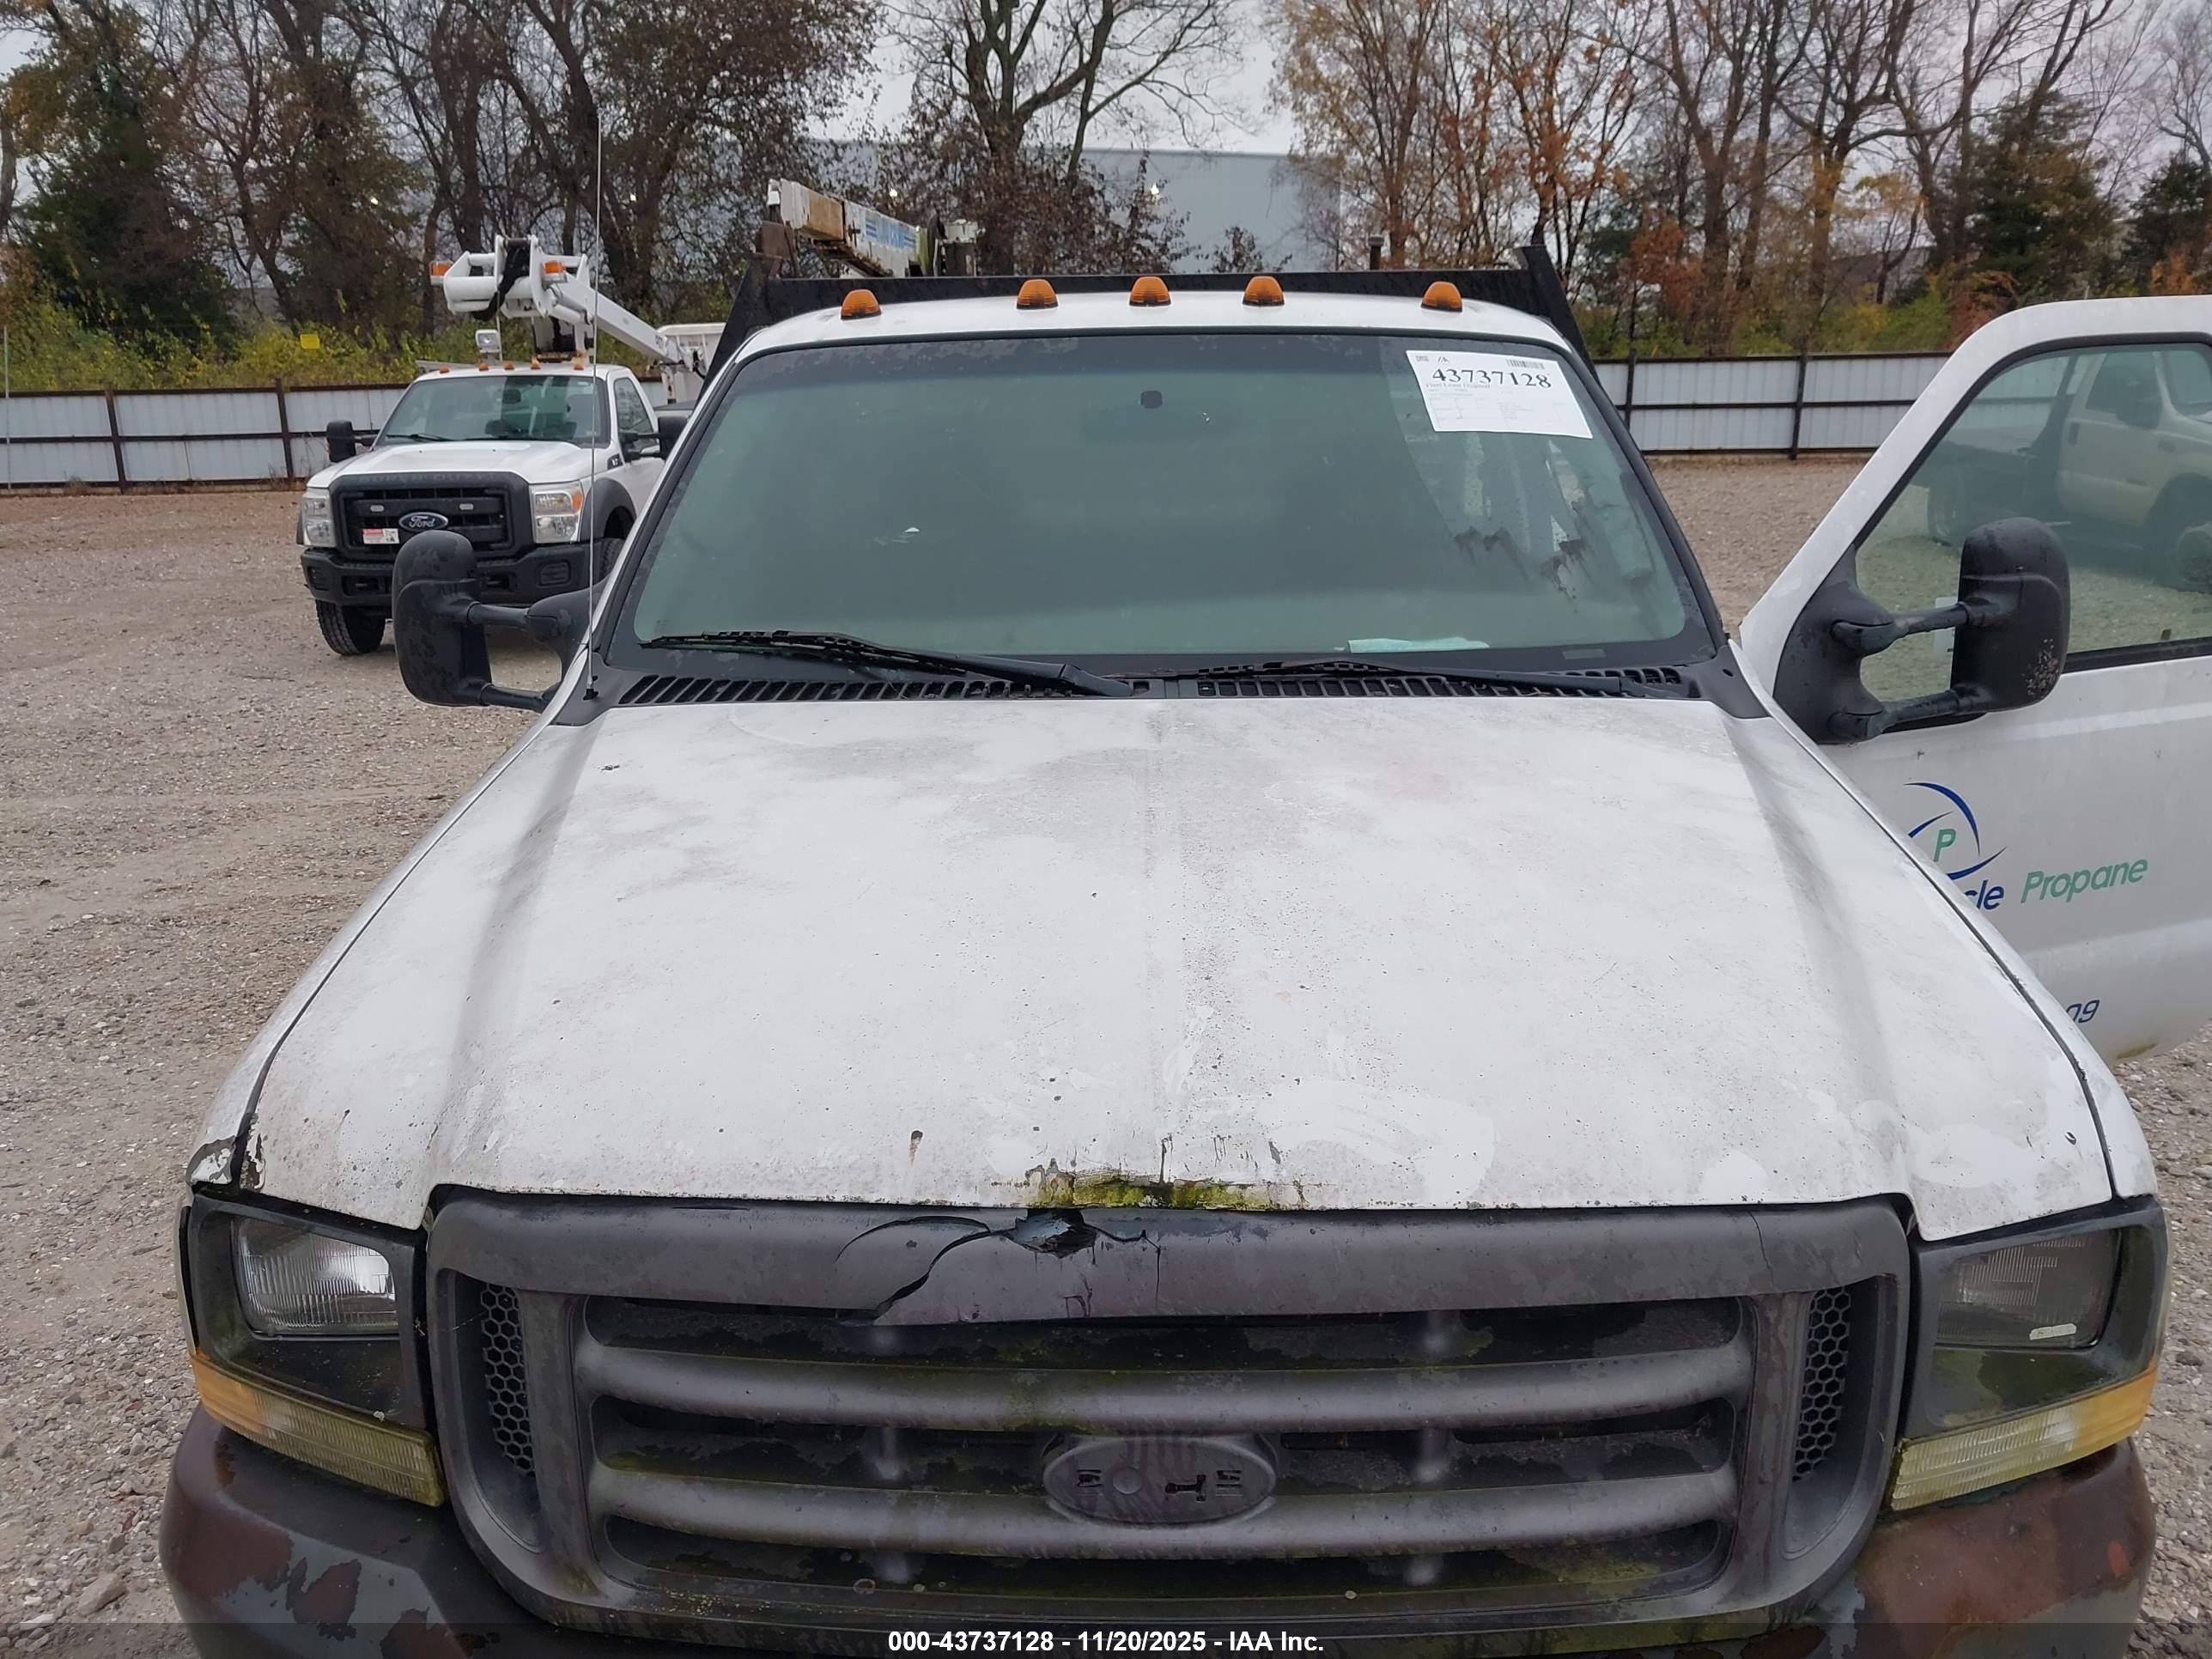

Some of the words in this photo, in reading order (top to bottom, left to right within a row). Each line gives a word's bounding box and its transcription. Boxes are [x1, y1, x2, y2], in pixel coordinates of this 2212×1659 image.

[1432, 368, 1552, 389] 43737128
[409, 515, 436, 528] Ford
[1934, 828, 1957, 862] P
[2021, 858, 2148, 903] Propane
